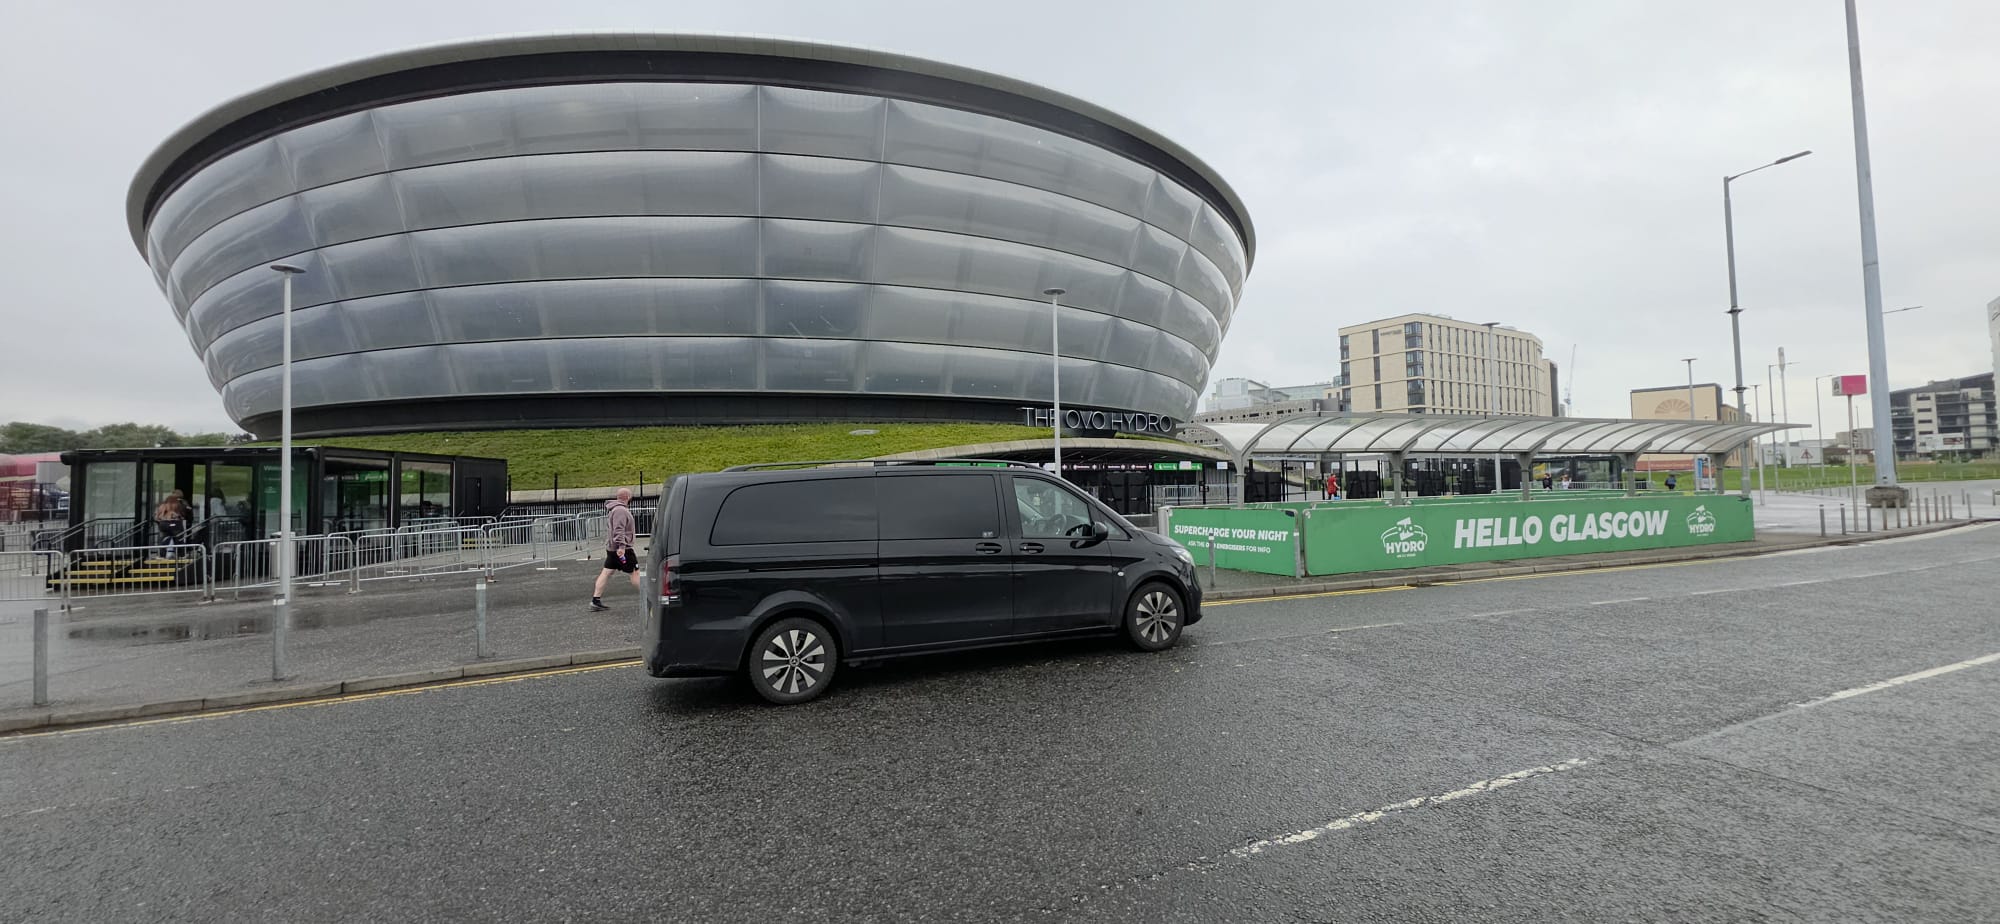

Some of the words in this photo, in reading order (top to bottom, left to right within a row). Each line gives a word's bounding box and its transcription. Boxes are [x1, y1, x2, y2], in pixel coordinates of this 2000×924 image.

[1020, 407, 1055, 428] THE
[1066, 409, 1105, 430] OVO
[1111, 412, 1172, 432] HYDRO
[1174, 524, 1230, 538] SUPERCHARGE
[1231, 528, 1257, 540] YOUR
[1257, 530, 1289, 542] NIGHT
[1454, 515, 1543, 548] HELLO
[1550, 510, 1669, 542] GLASGOW
[1689, 523, 1714, 534] HYDRO
[1216, 543, 1245, 552] ENERGISERS
[1257, 546, 1271, 554] INFO
[1386, 540, 1425, 554] HYDRO
